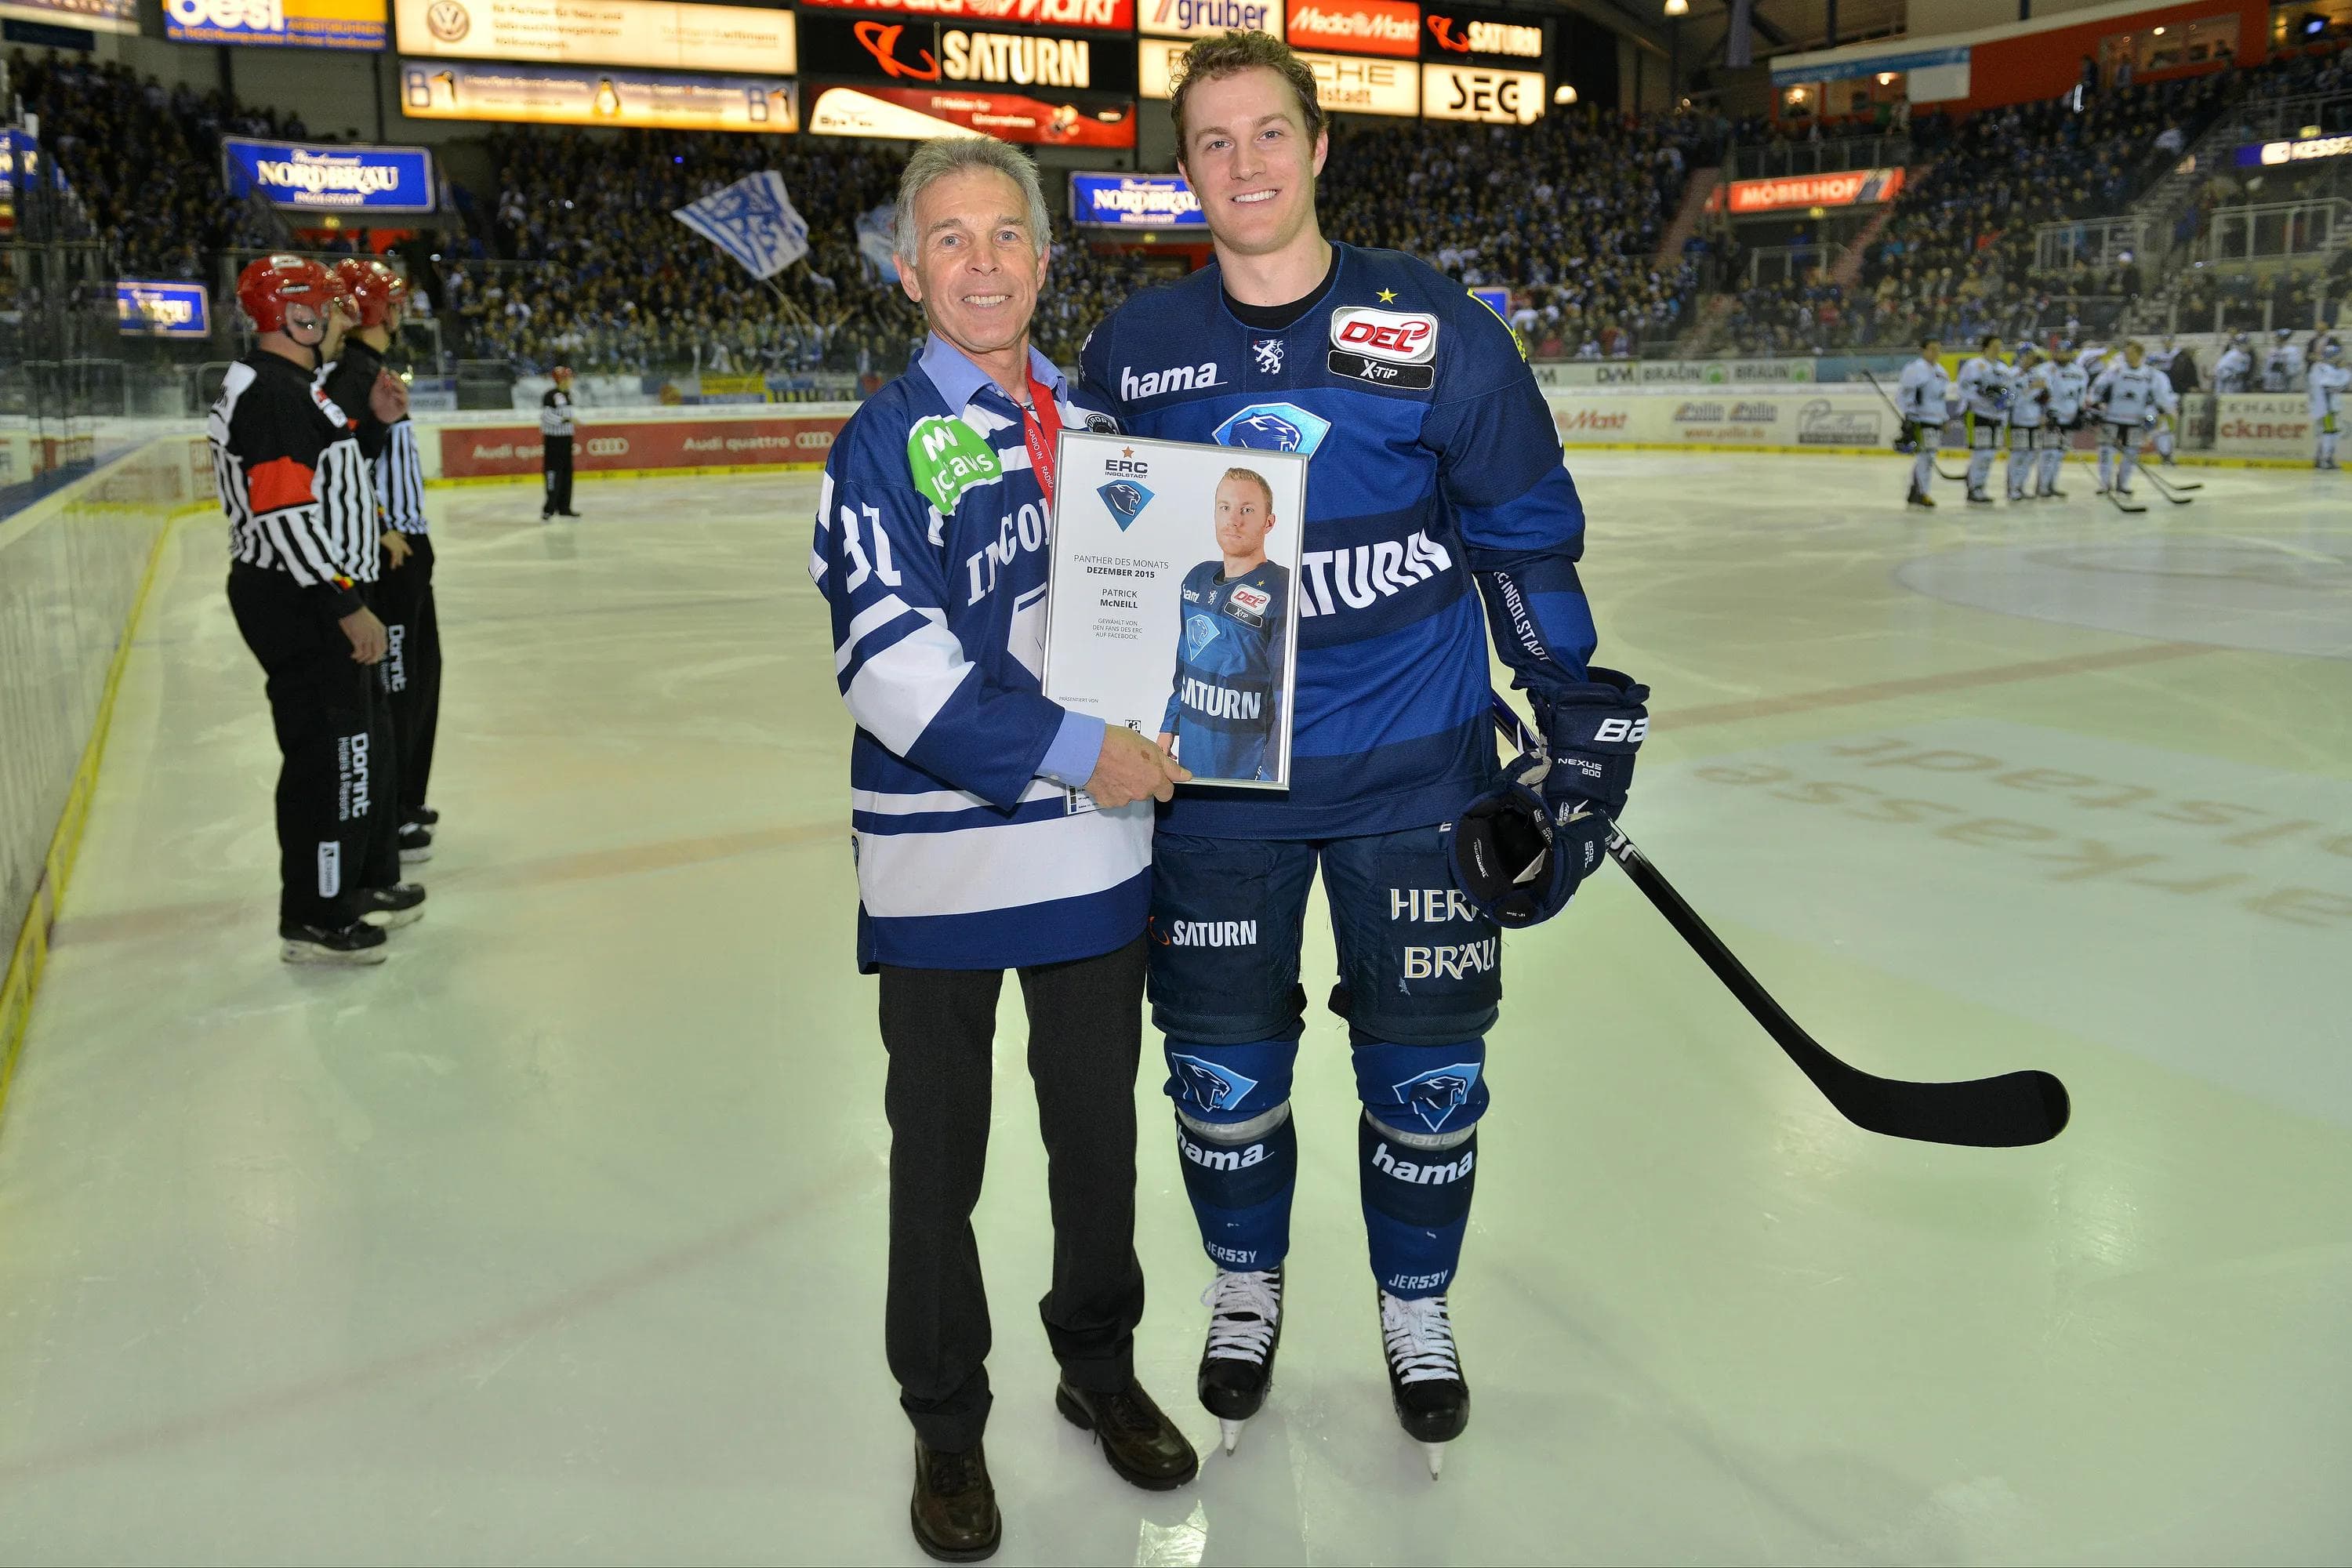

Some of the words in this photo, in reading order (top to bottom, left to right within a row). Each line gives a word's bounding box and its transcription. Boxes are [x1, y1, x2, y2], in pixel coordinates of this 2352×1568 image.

[1468, 21, 1542, 57] SATURN
[942, 29, 1090, 89] SATURN
[1740, 177, 1858, 206] MÖBELHOF
[1121, 361, 1228, 402] hama
[683, 435, 722, 452] Audi
[1105, 459, 1149, 474] ERC
[1073, 554, 1112, 565] PANTHER
[1115, 557, 1131, 566] DES
[1133, 559, 1169, 569] MONATS
[1087, 566, 1132, 577] DEZEMBER
[1134, 570, 1155, 579] 2015
[1100, 599, 1138, 608] McNEILL
[1102, 589, 1138, 598] PATRICK
[1500, 576, 1552, 662] INGOLSTADT
[350, 731, 372, 818] Dorint
[1558, 757, 1602, 771] NEXUS
[1581, 768, 1602, 779] 800
[1172, 920, 1257, 948] SATURN
[1403, 936, 1496, 981] BRÄU
[1176, 1121, 1272, 1172] hama
[1372, 1142, 1474, 1185] hama
